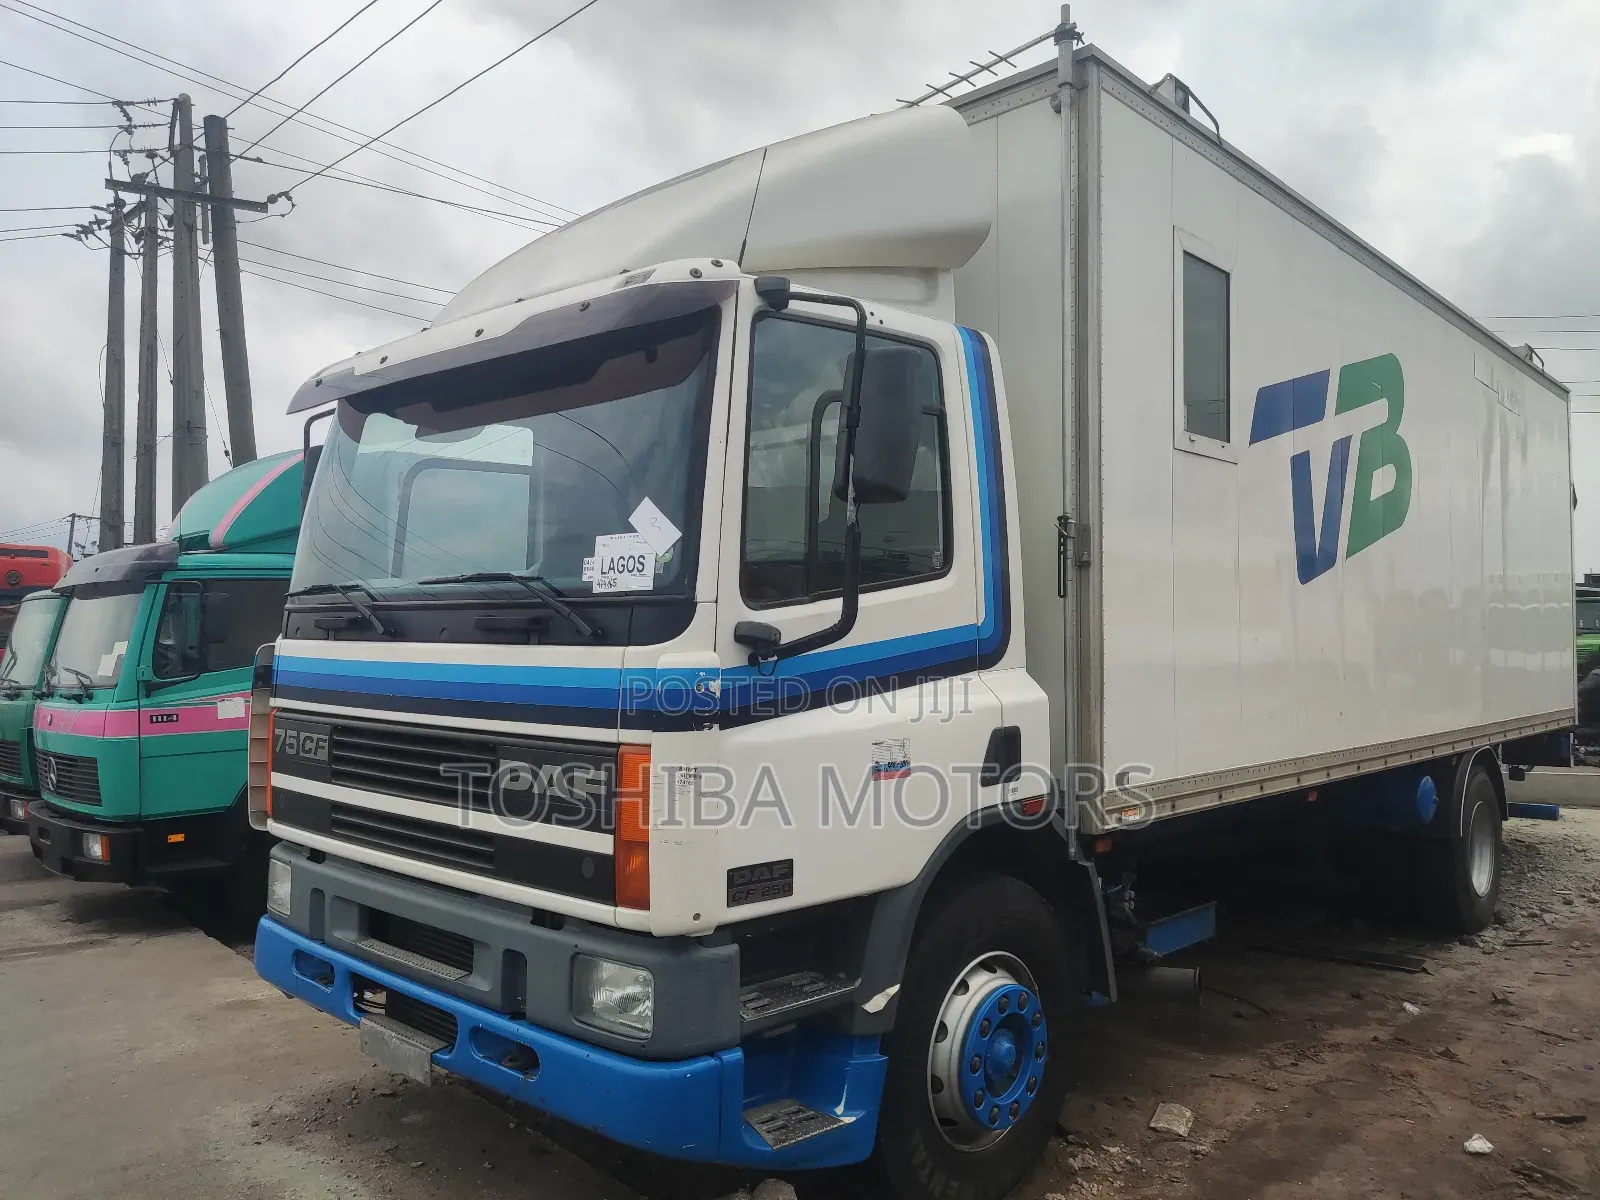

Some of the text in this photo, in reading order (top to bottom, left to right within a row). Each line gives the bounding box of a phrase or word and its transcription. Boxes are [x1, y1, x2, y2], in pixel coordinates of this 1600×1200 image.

[600, 554, 646, 576] LAGOS
[499, 758, 611, 800] DAF
[733, 863, 789, 885] DAF
[731, 882, 792, 905] CF 250
